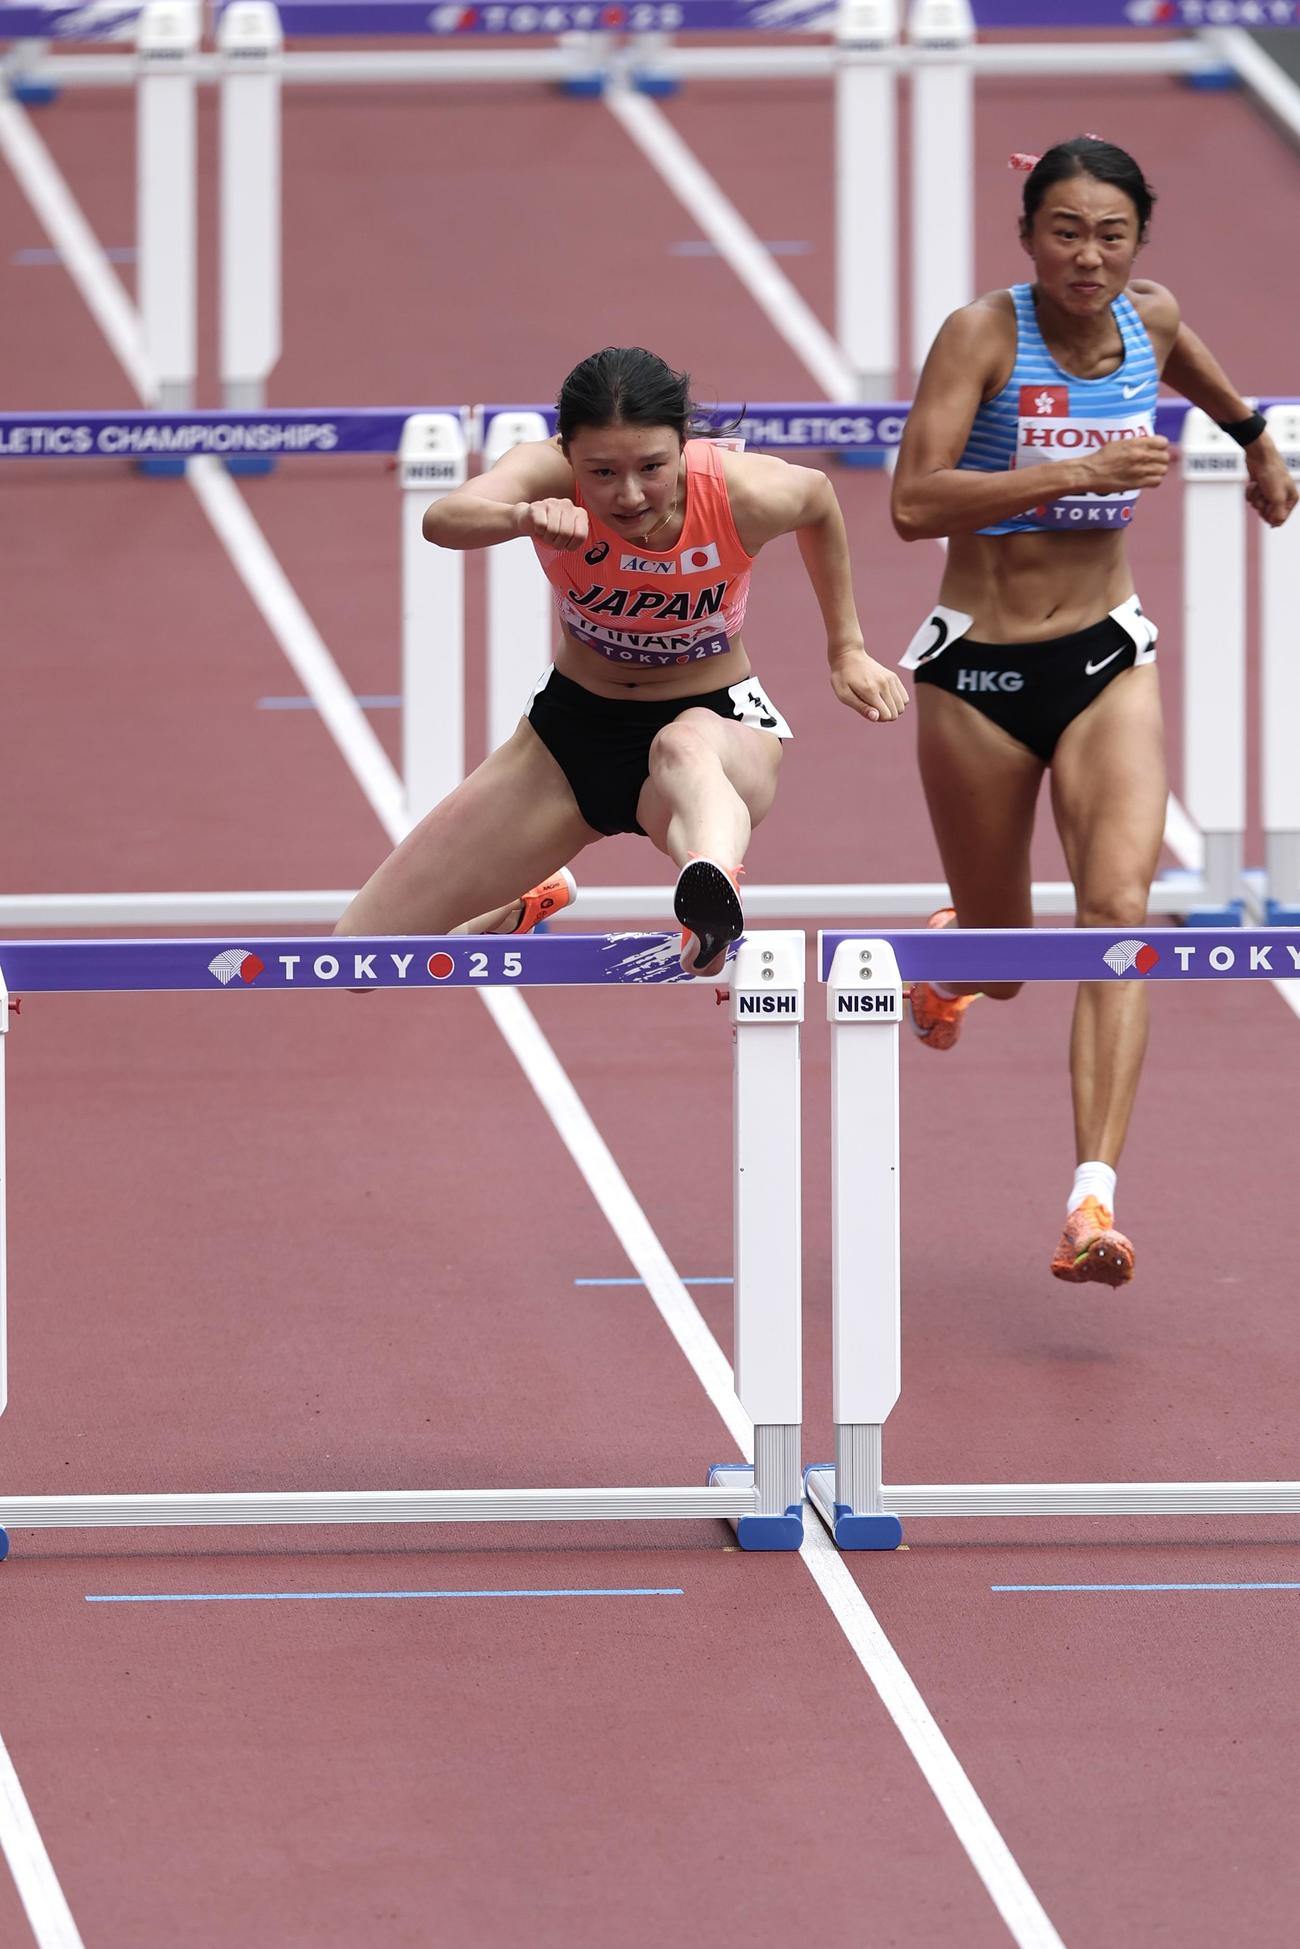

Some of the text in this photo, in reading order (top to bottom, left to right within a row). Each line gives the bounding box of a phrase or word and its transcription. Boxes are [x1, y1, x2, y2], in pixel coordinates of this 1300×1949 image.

[97, 424, 338, 452] CHAMPIONSHIPS
[622, 557, 674, 574] ACN
[568, 581, 728, 621] JAPAN
[956, 669, 1025, 692] HKG
[739, 996, 796, 1013] NISHI
[838, 995, 895, 1013] NISHI
